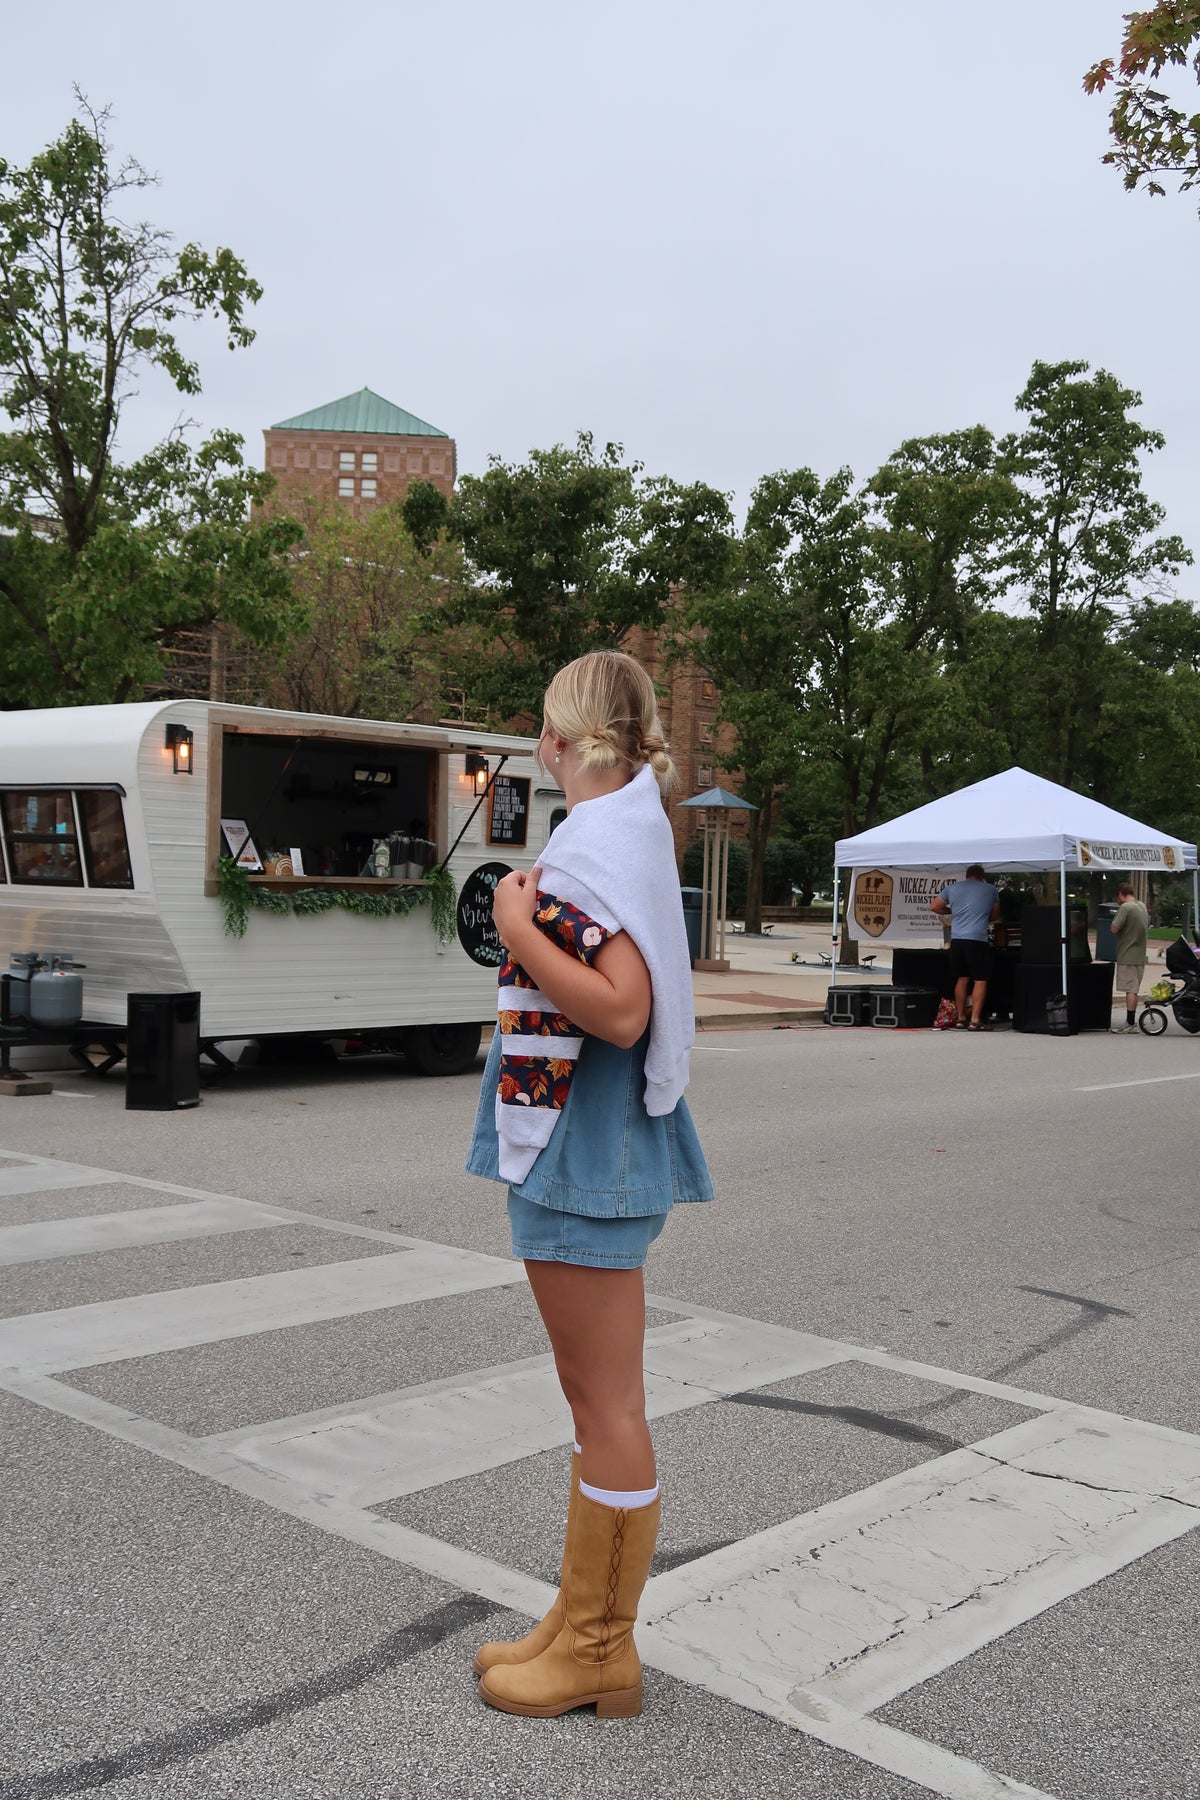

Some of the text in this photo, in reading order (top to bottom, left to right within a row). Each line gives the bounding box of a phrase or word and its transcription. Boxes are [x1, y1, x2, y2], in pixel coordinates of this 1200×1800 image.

[1112, 847, 1130, 861] PLATE
[1130, 848, 1161, 862] FARMSTEAD
[899, 877, 928, 894] NICKEL
[856, 894, 891, 906] NICKEL PLATE
